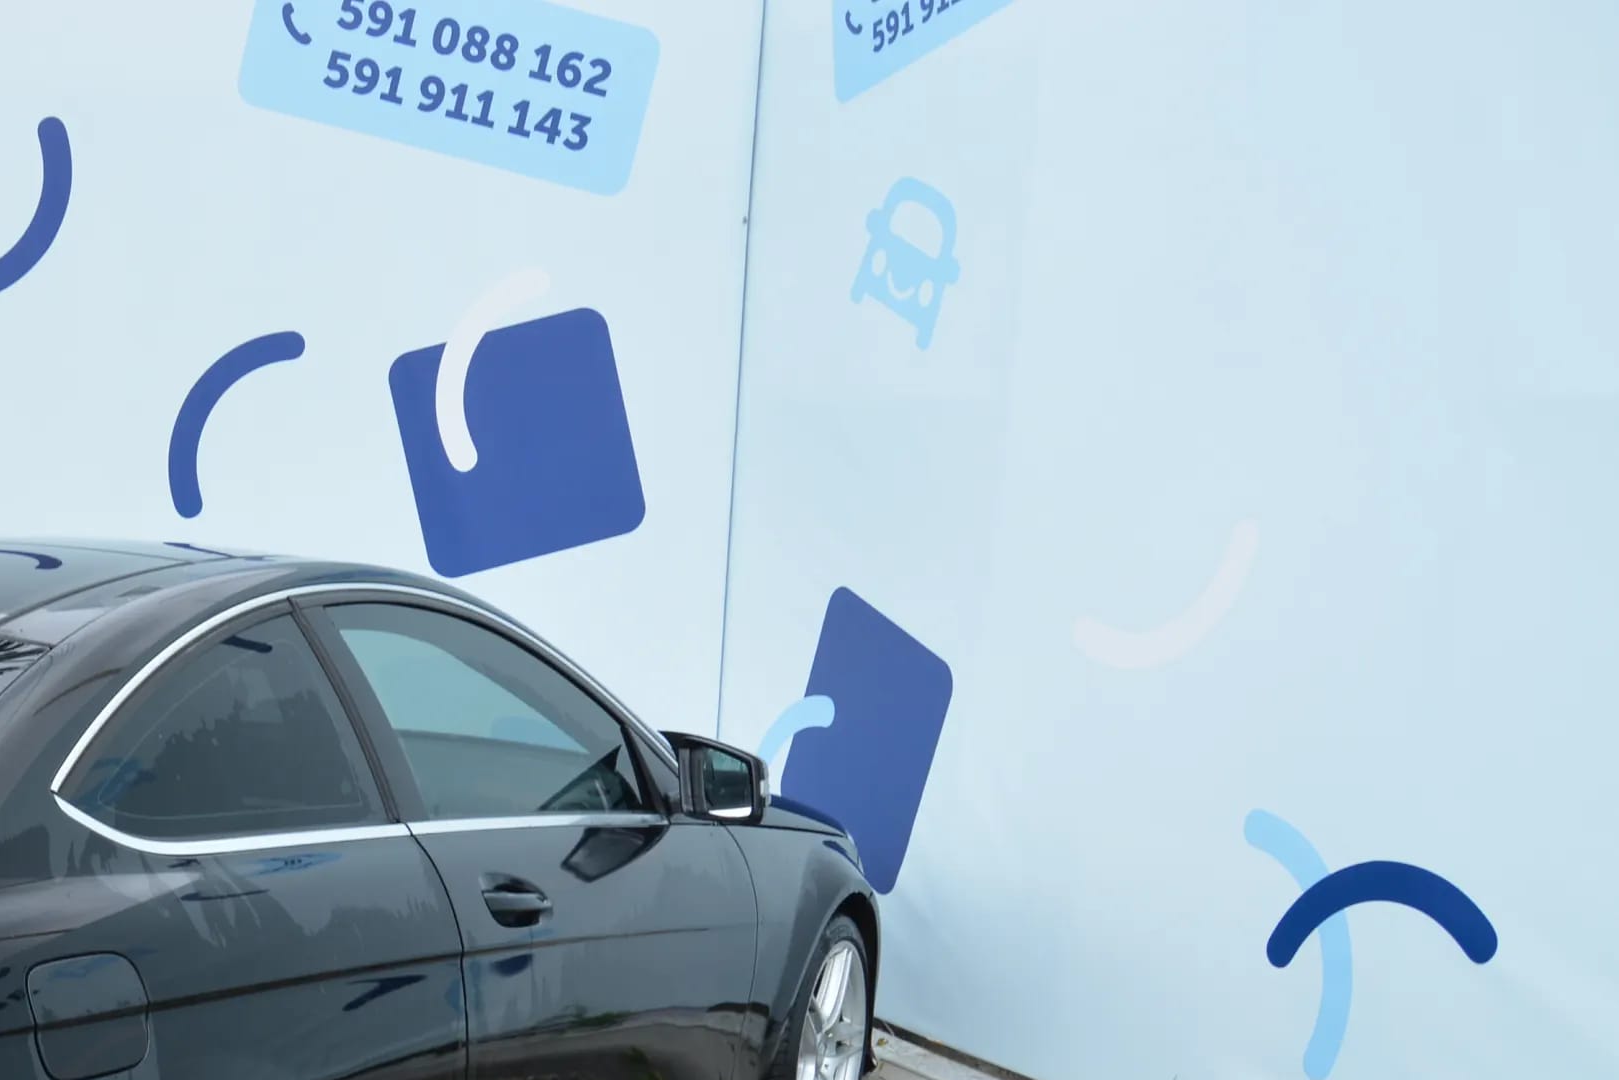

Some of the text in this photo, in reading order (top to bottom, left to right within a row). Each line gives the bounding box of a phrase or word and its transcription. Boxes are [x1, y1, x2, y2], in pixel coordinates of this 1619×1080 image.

[336, 0, 612, 98] 591 088 162
[872, 0, 915, 53] 591
[322, 49, 592, 152] 591 911 143
